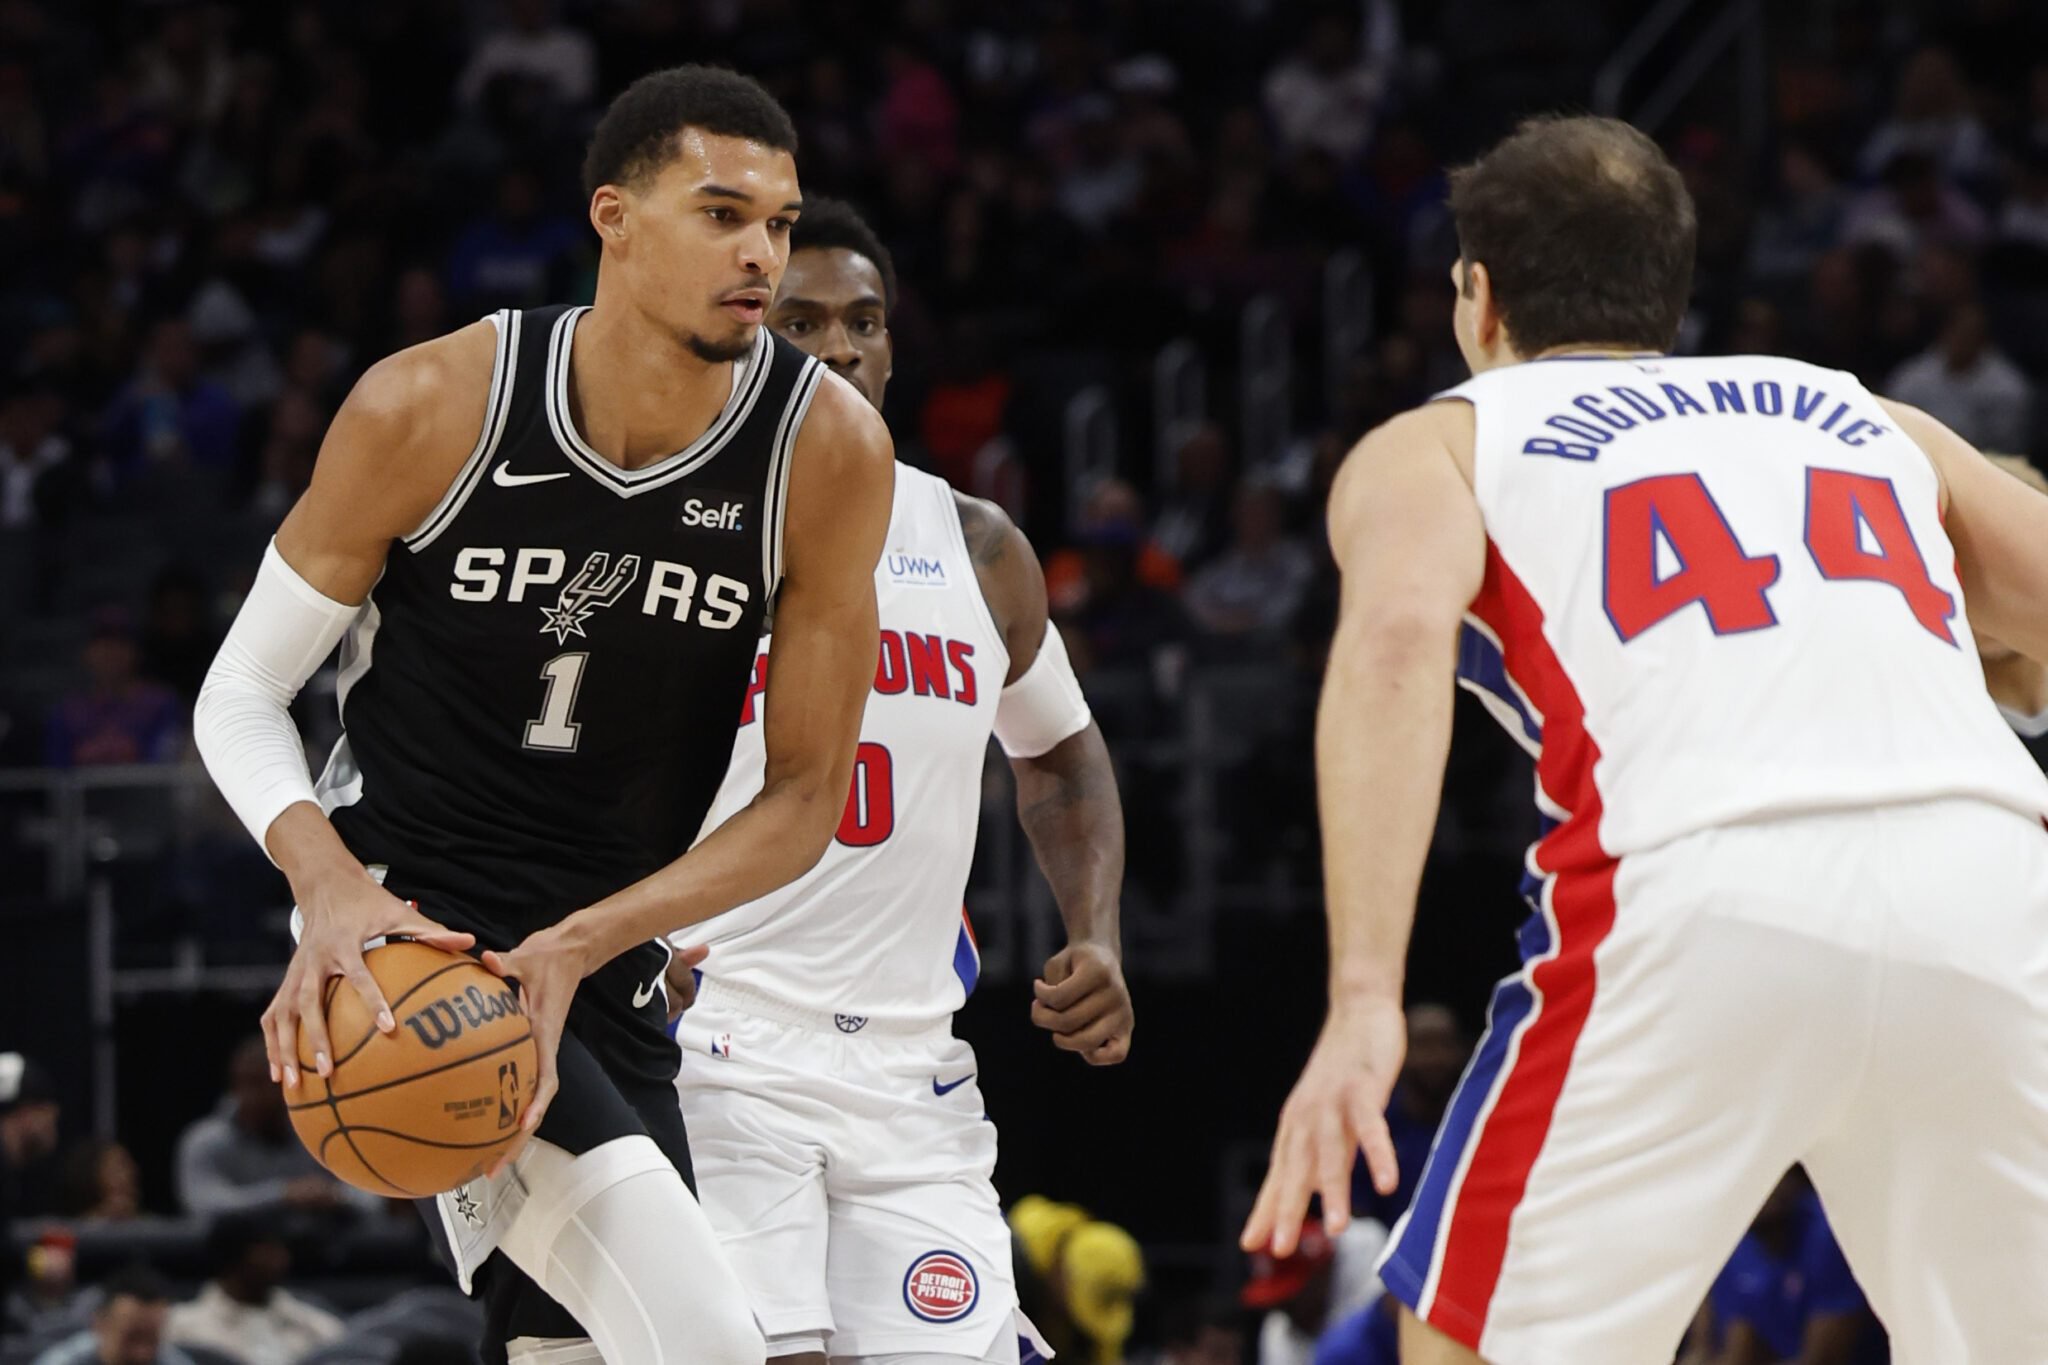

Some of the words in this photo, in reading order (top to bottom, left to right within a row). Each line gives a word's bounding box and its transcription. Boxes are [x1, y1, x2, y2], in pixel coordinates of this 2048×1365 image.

[681, 498, 743, 531] Self.
[888, 555, 945, 578] UWM
[1602, 466, 1961, 649] 44
[450, 547, 750, 645] SPURS
[521, 651, 590, 753] 1
[917, 1284, 964, 1303] PISTONS
[920, 1272, 966, 1290] DETROIT
